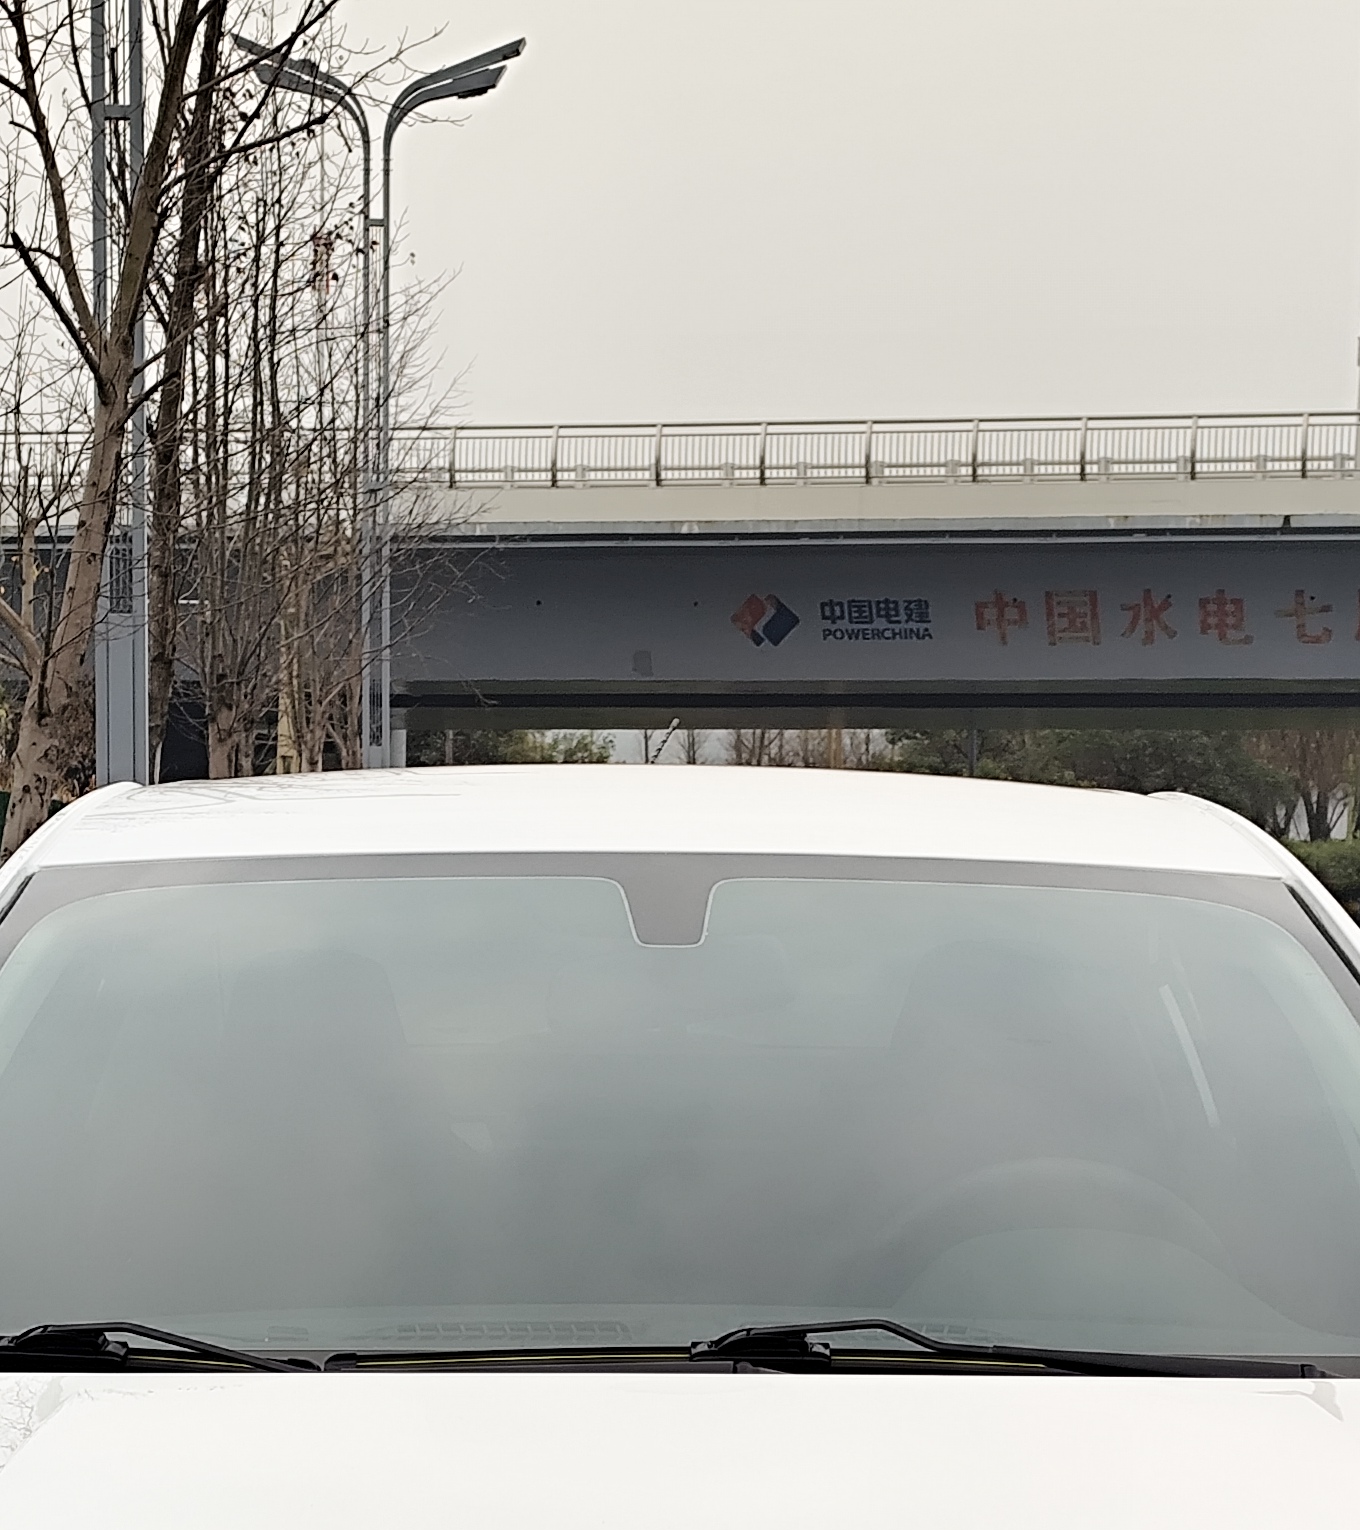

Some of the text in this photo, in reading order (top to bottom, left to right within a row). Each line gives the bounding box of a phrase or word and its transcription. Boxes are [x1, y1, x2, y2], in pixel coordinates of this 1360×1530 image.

[820, 598, 932, 625] 中国电建
[822, 628, 933, 641] POWERCHINA
